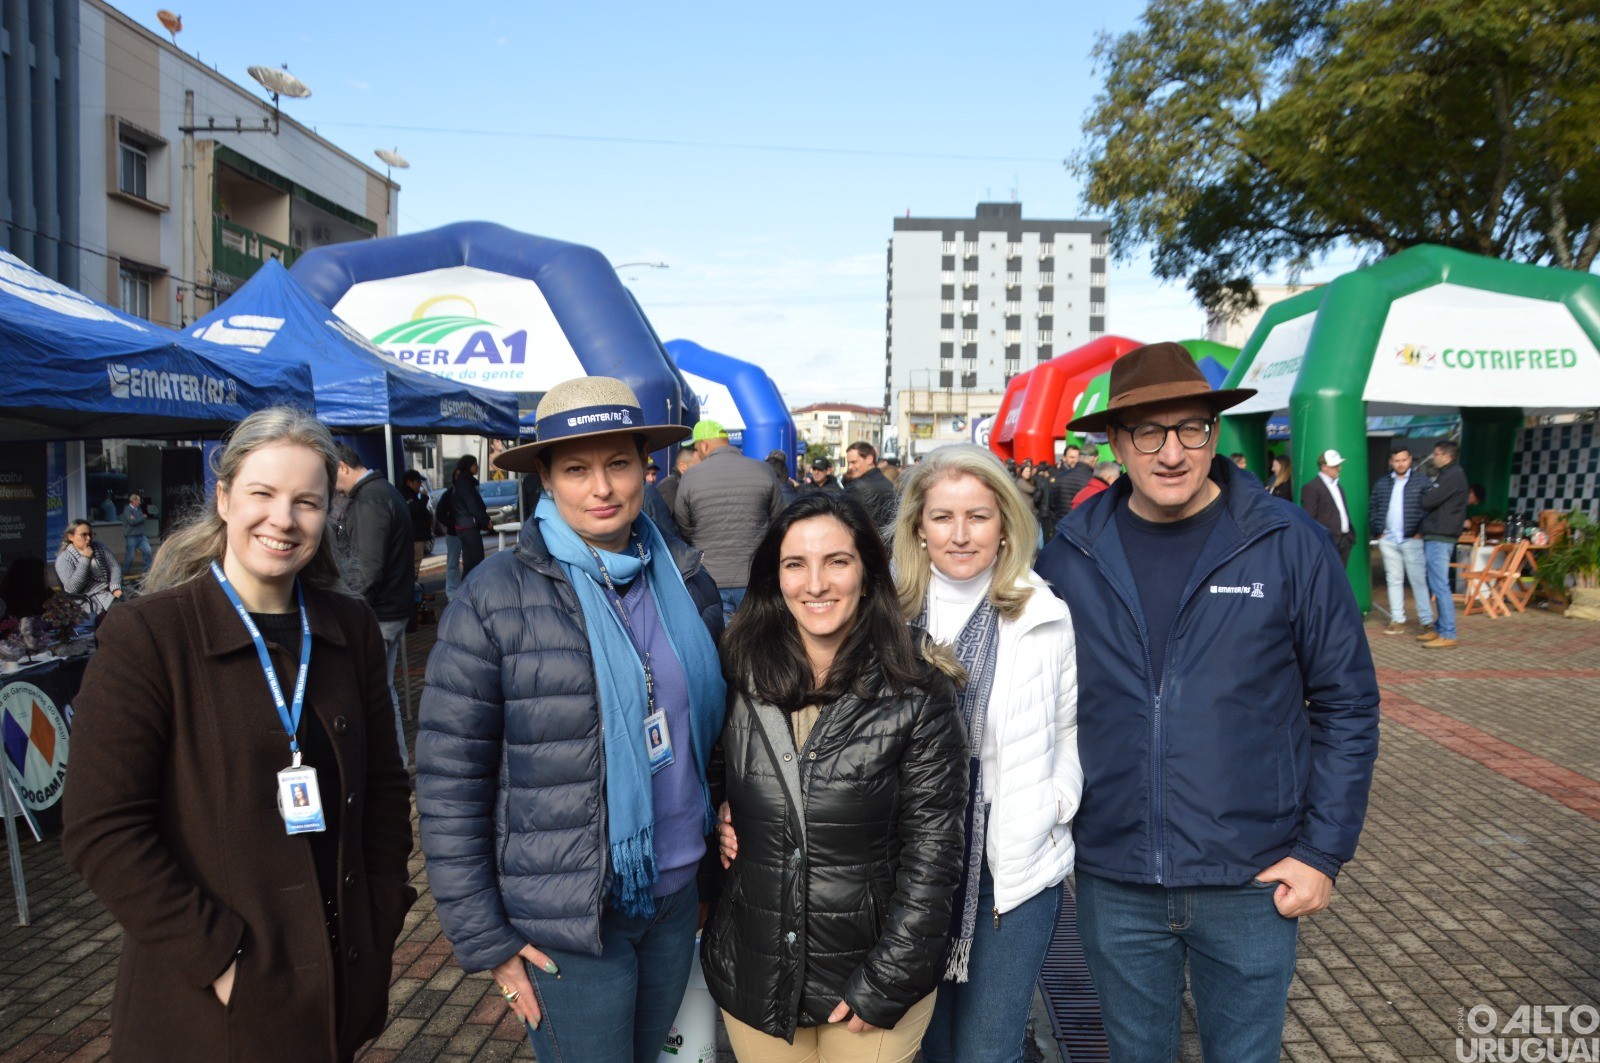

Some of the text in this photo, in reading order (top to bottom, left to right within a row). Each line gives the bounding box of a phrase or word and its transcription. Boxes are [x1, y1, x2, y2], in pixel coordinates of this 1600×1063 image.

[386, 329, 528, 365] PER A1
[1442, 348, 1577, 369] COTRIFRED
[130, 368, 224, 404] EMATER/RS
[459, 369, 477, 379] da
[481, 369, 524, 381] gente
[577, 412, 621, 424] EMATER/RS
[1218, 585, 1251, 594] EMATER/RS
[11, 687, 47, 706] Garimpeiros
[54, 716, 67, 740] Brasil
[14, 761, 68, 804] OOGAMAI
